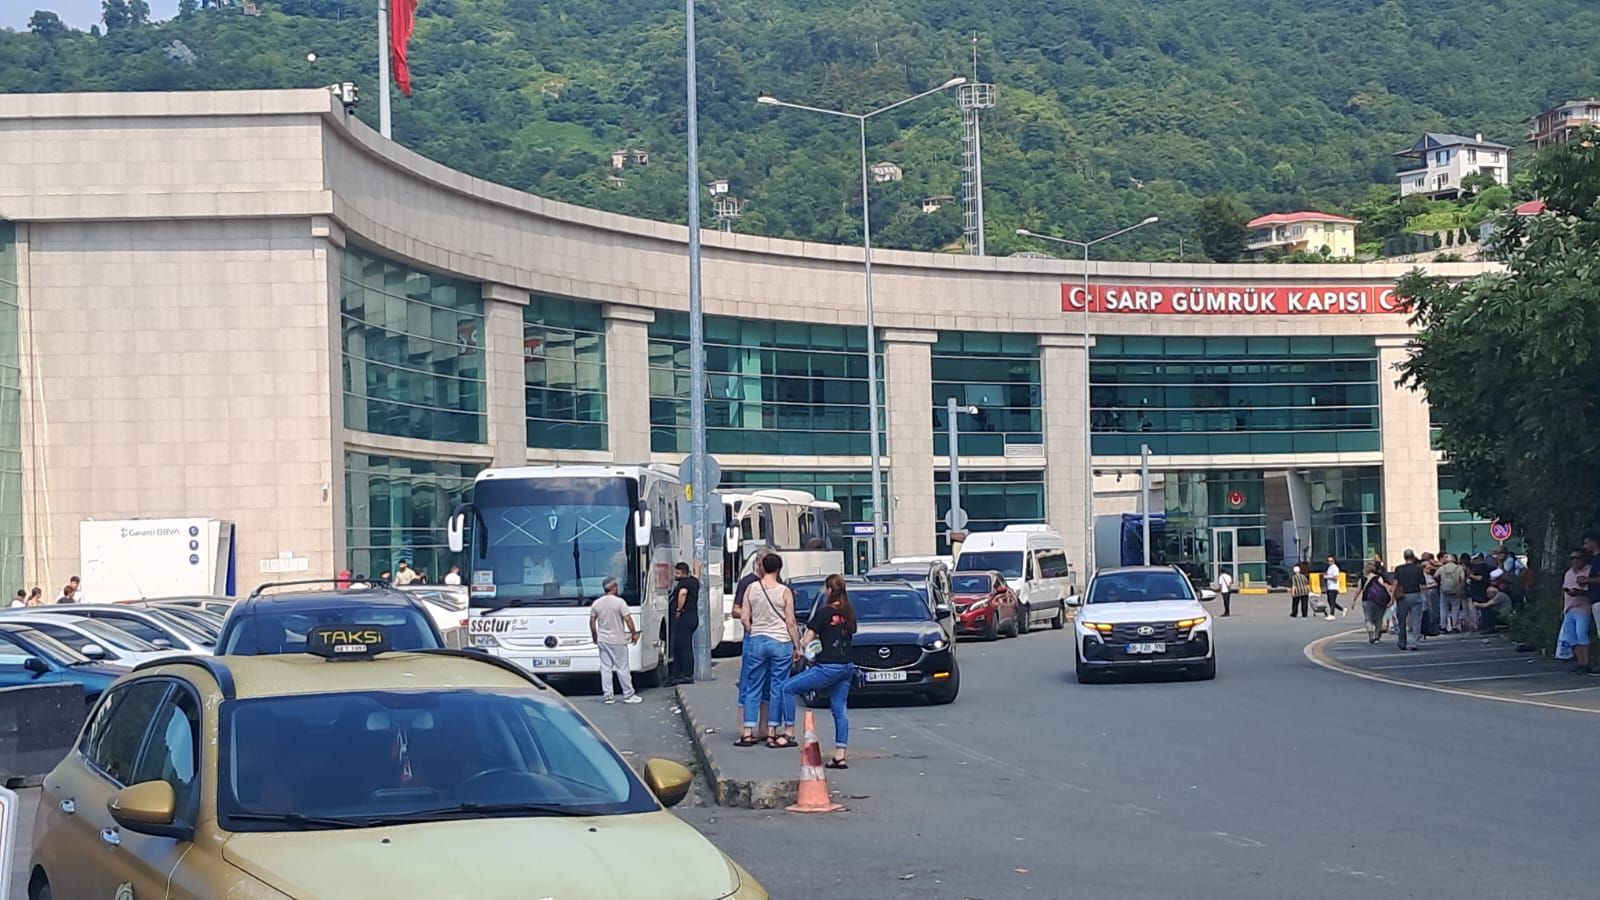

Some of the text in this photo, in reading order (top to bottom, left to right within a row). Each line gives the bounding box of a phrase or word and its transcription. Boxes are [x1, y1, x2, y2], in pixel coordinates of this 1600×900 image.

[1105, 287, 1367, 312] SARP GÜMRÜK KAPISI
[128, 528, 180, 537] Garanti BBVA
[470, 618, 512, 633] ssctur
